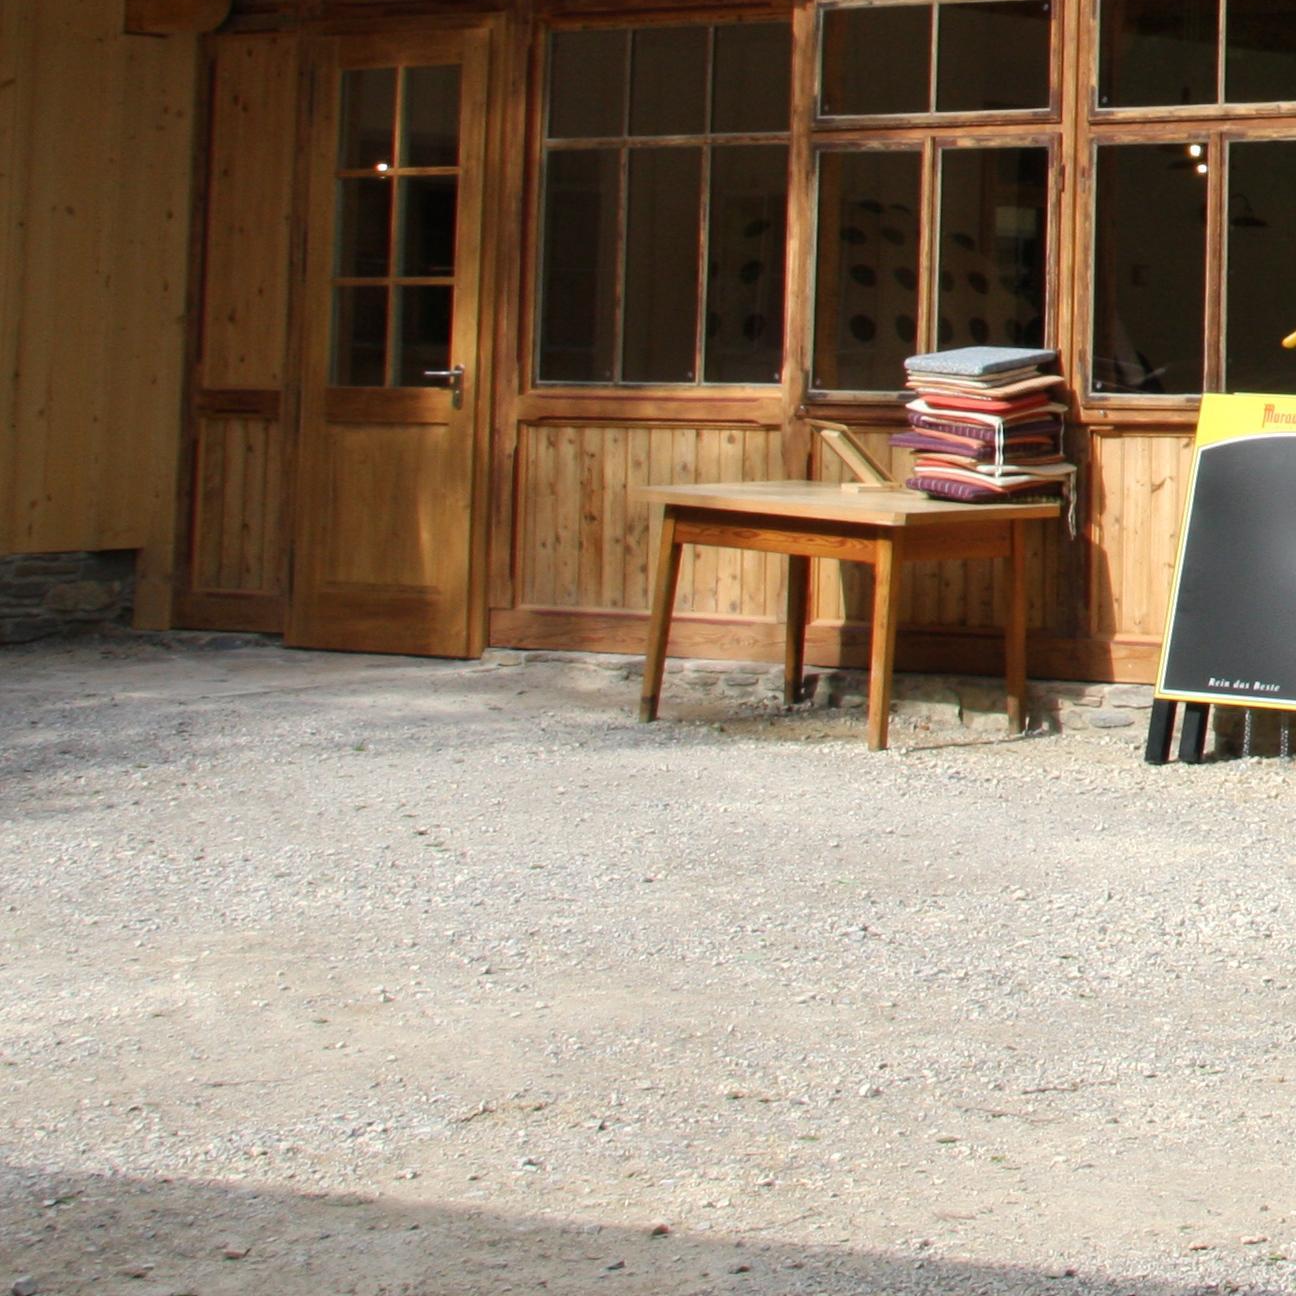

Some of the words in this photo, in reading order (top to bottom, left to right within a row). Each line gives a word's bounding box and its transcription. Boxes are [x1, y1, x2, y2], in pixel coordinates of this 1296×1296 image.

[1208, 677, 1230, 688] Rein
[1233, 680, 1250, 689] das
[1253, 681, 1281, 692] Beste
